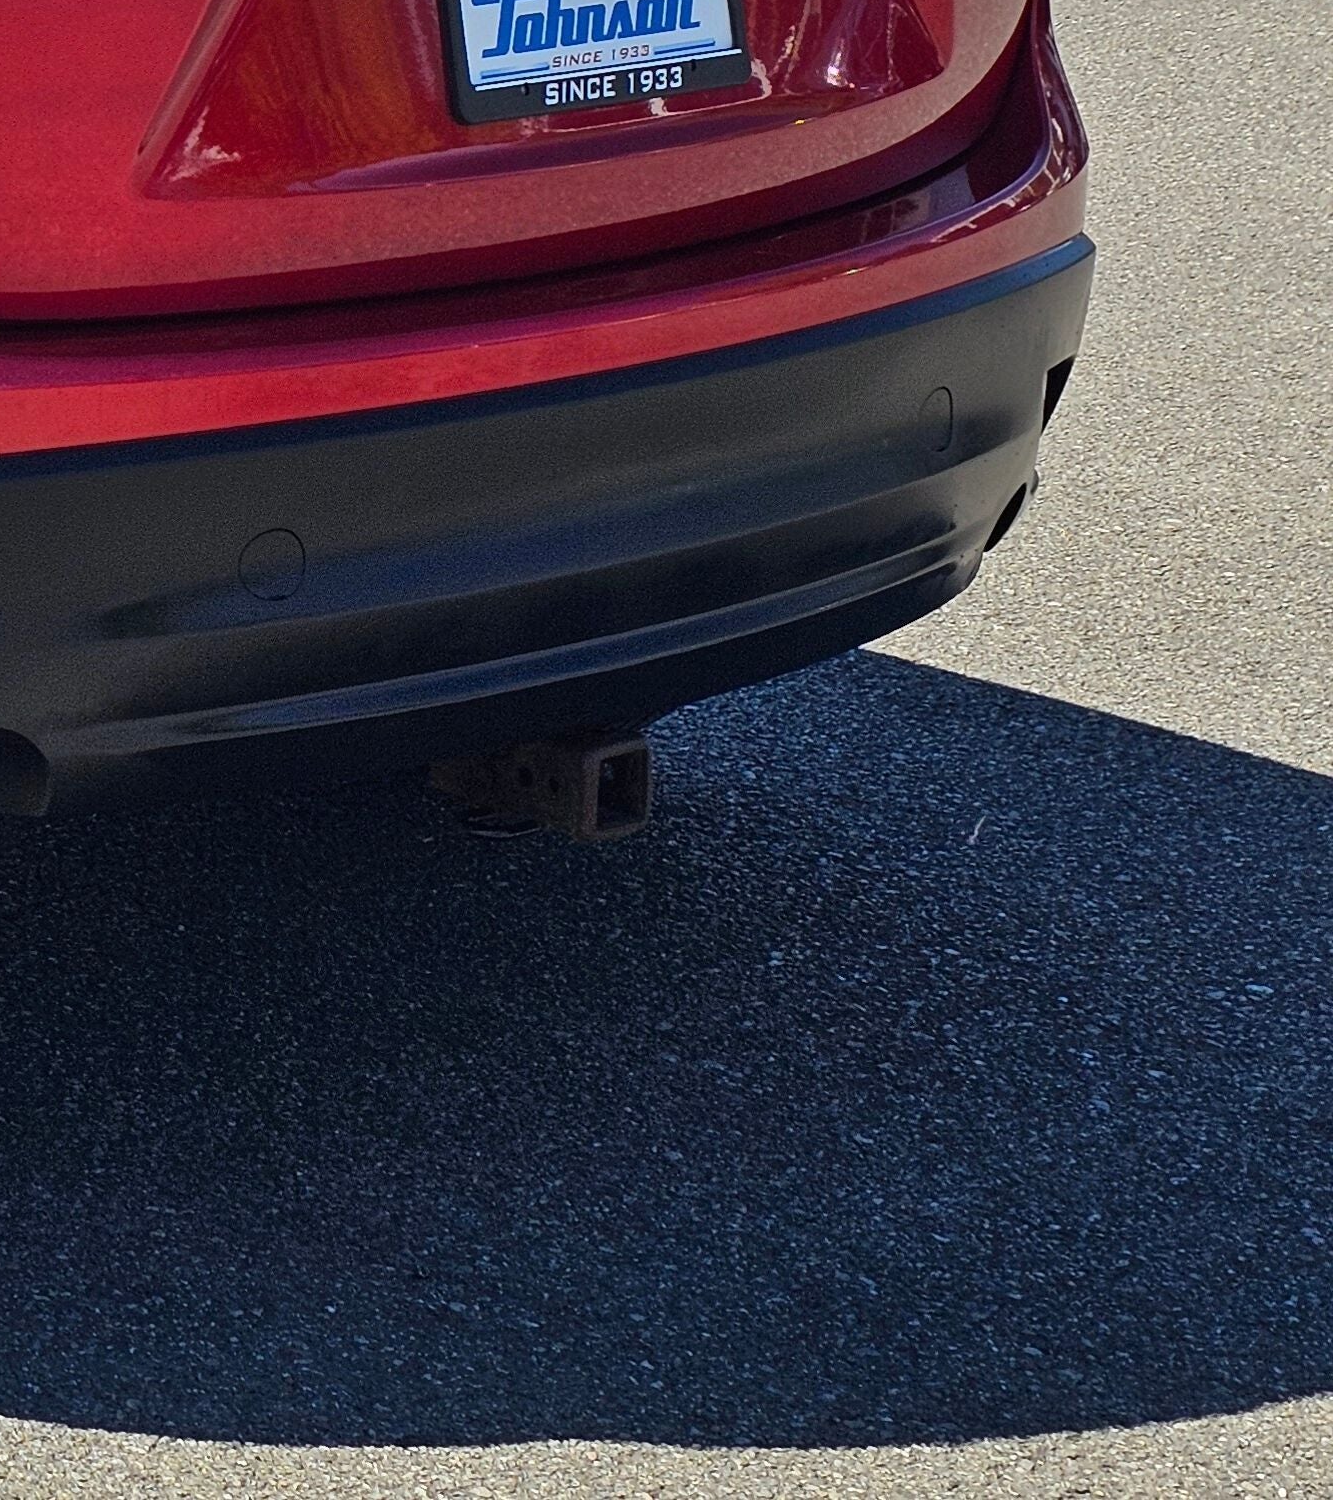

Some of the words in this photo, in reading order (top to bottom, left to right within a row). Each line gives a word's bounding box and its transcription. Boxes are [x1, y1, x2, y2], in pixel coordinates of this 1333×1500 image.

[552, 51, 603, 68] SINCE
[612, 45, 650, 61] 1933
[545, 75, 617, 105] SINCE
[628, 66, 683, 94] 1933
